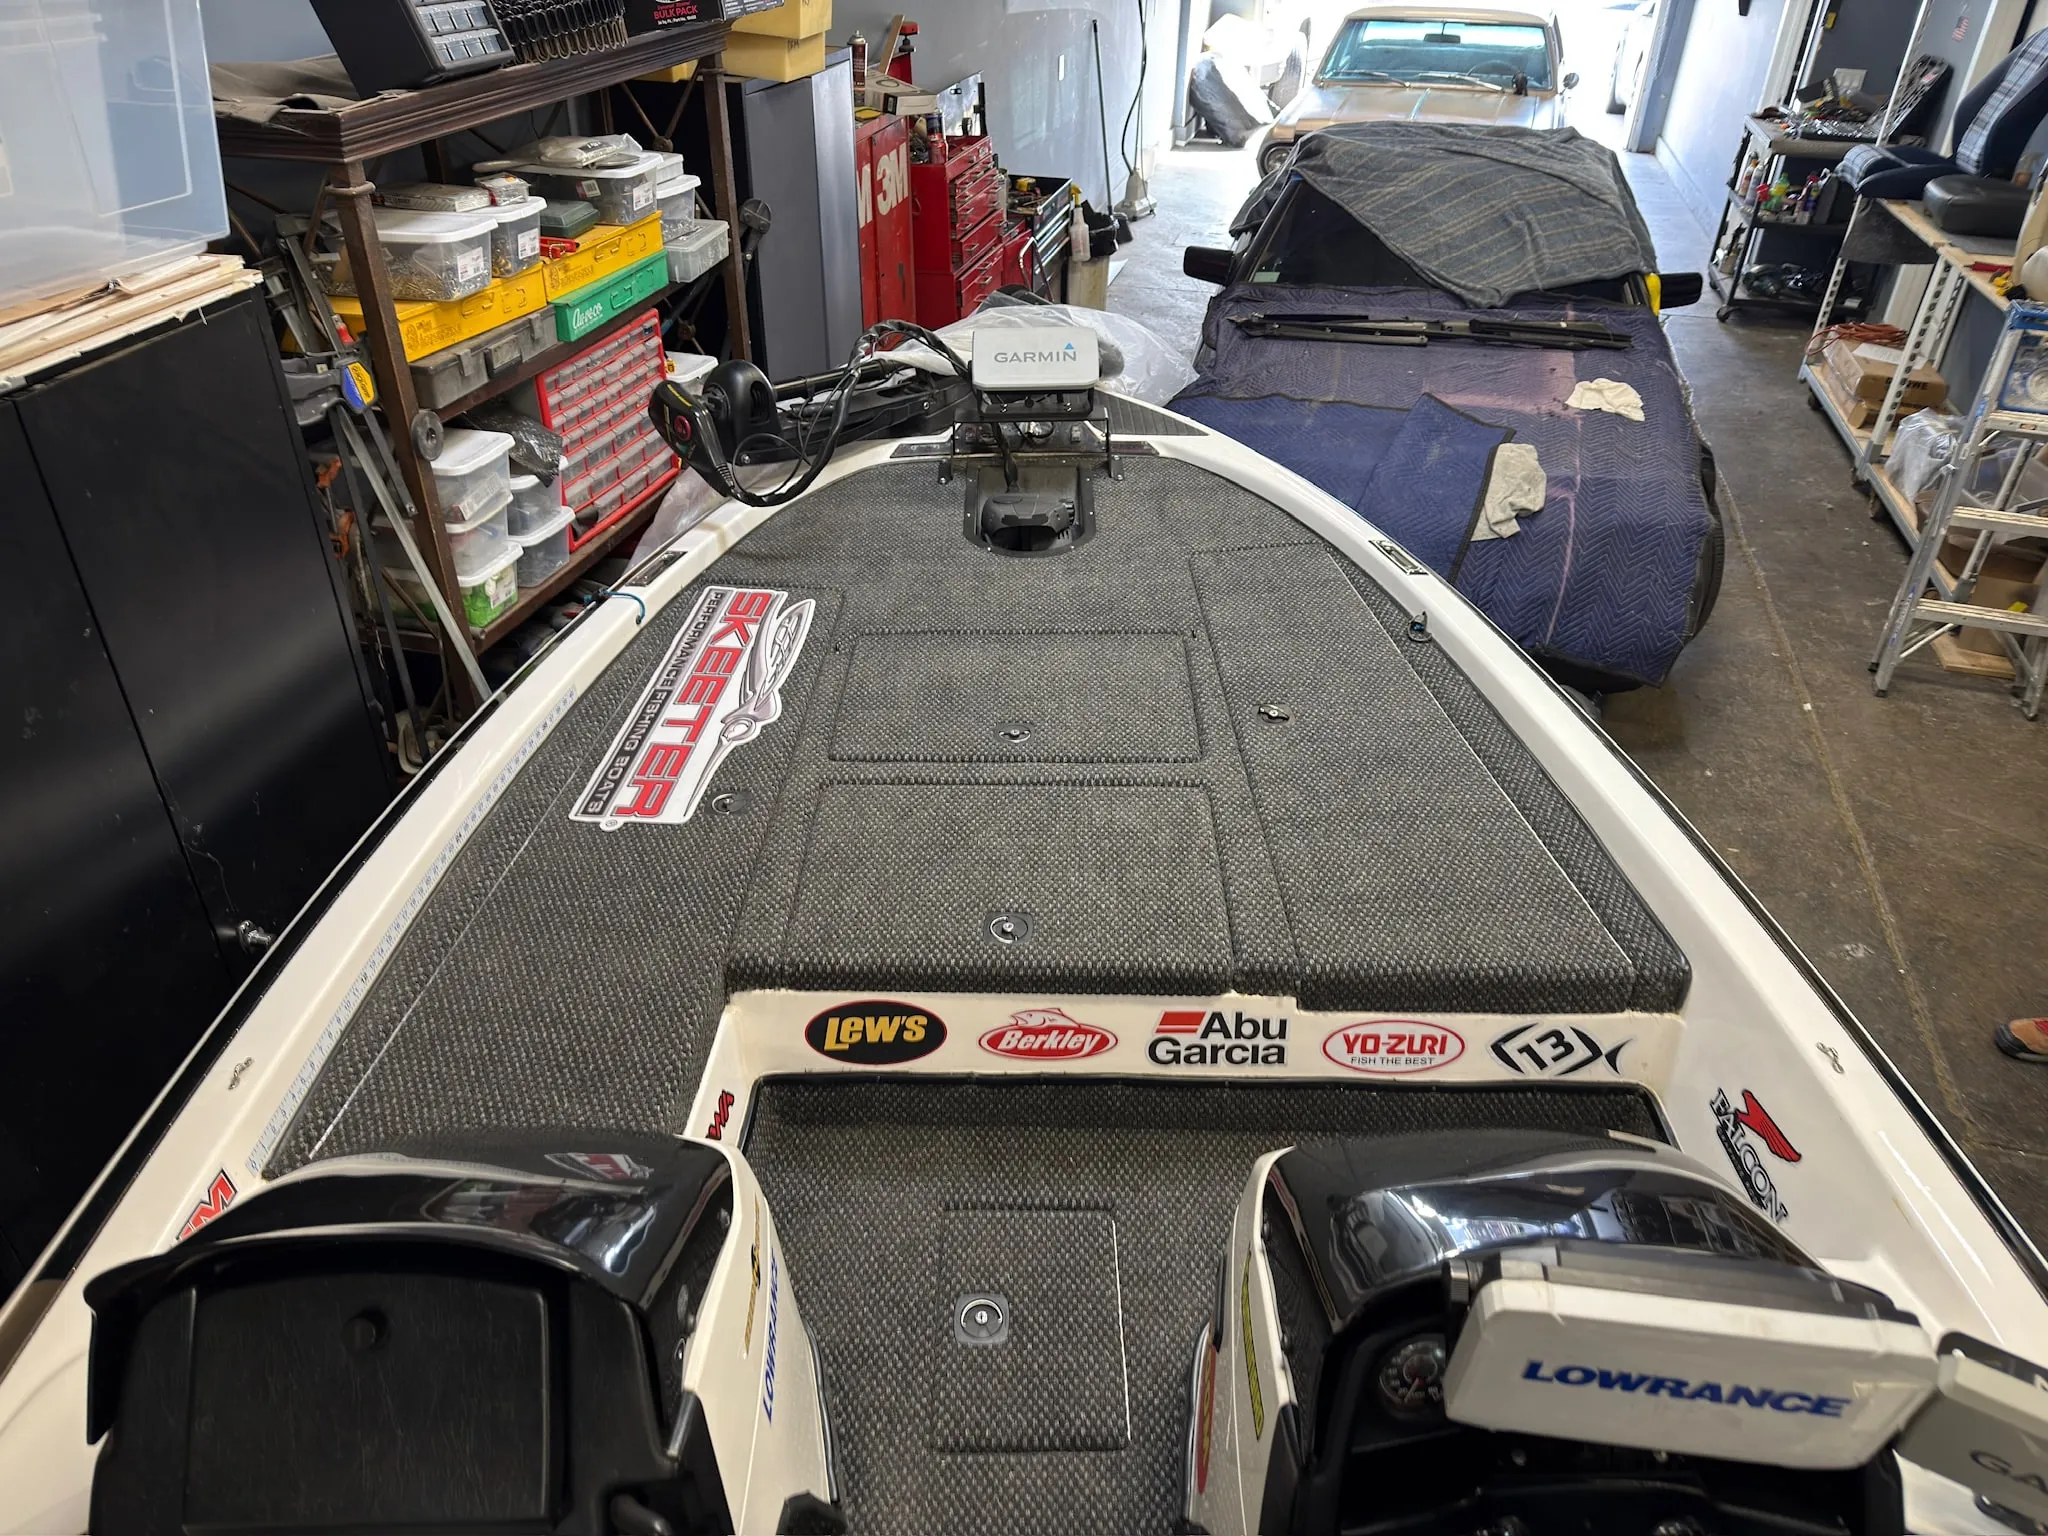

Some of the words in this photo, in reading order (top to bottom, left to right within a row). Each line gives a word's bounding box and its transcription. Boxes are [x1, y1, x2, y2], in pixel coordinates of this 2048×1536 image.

[653, 8, 675, 20] BULK
[676, 5, 698, 16] PACK
[876, 142, 909, 216] 3M
[994, 350, 1077, 363] GARMIN
[660, 591, 723, 689] PERFORMANCE
[611, 590, 772, 818] SKEETER
[622, 689, 667, 752] FISHING
[587, 755, 628, 813] BOATS
[997, 1029, 1101, 1057] Berkley
[1148, 1037, 1286, 1065] Garcia
[1200, 1012, 1287, 1040] Abu
[1343, 1032, 1448, 1055] YO-ZURI
[1517, 1029, 1576, 1071] 13
[1350, 1056, 1376, 1066] FISH
[1378, 1056, 1403, 1066] THE
[1404, 1056, 1436, 1067] BEST
[1709, 1087, 1789, 1224] FALCON
[763, 1247, 779, 1425] LOWRANCE
[1521, 1359, 1853, 1418] LOWRANCE
